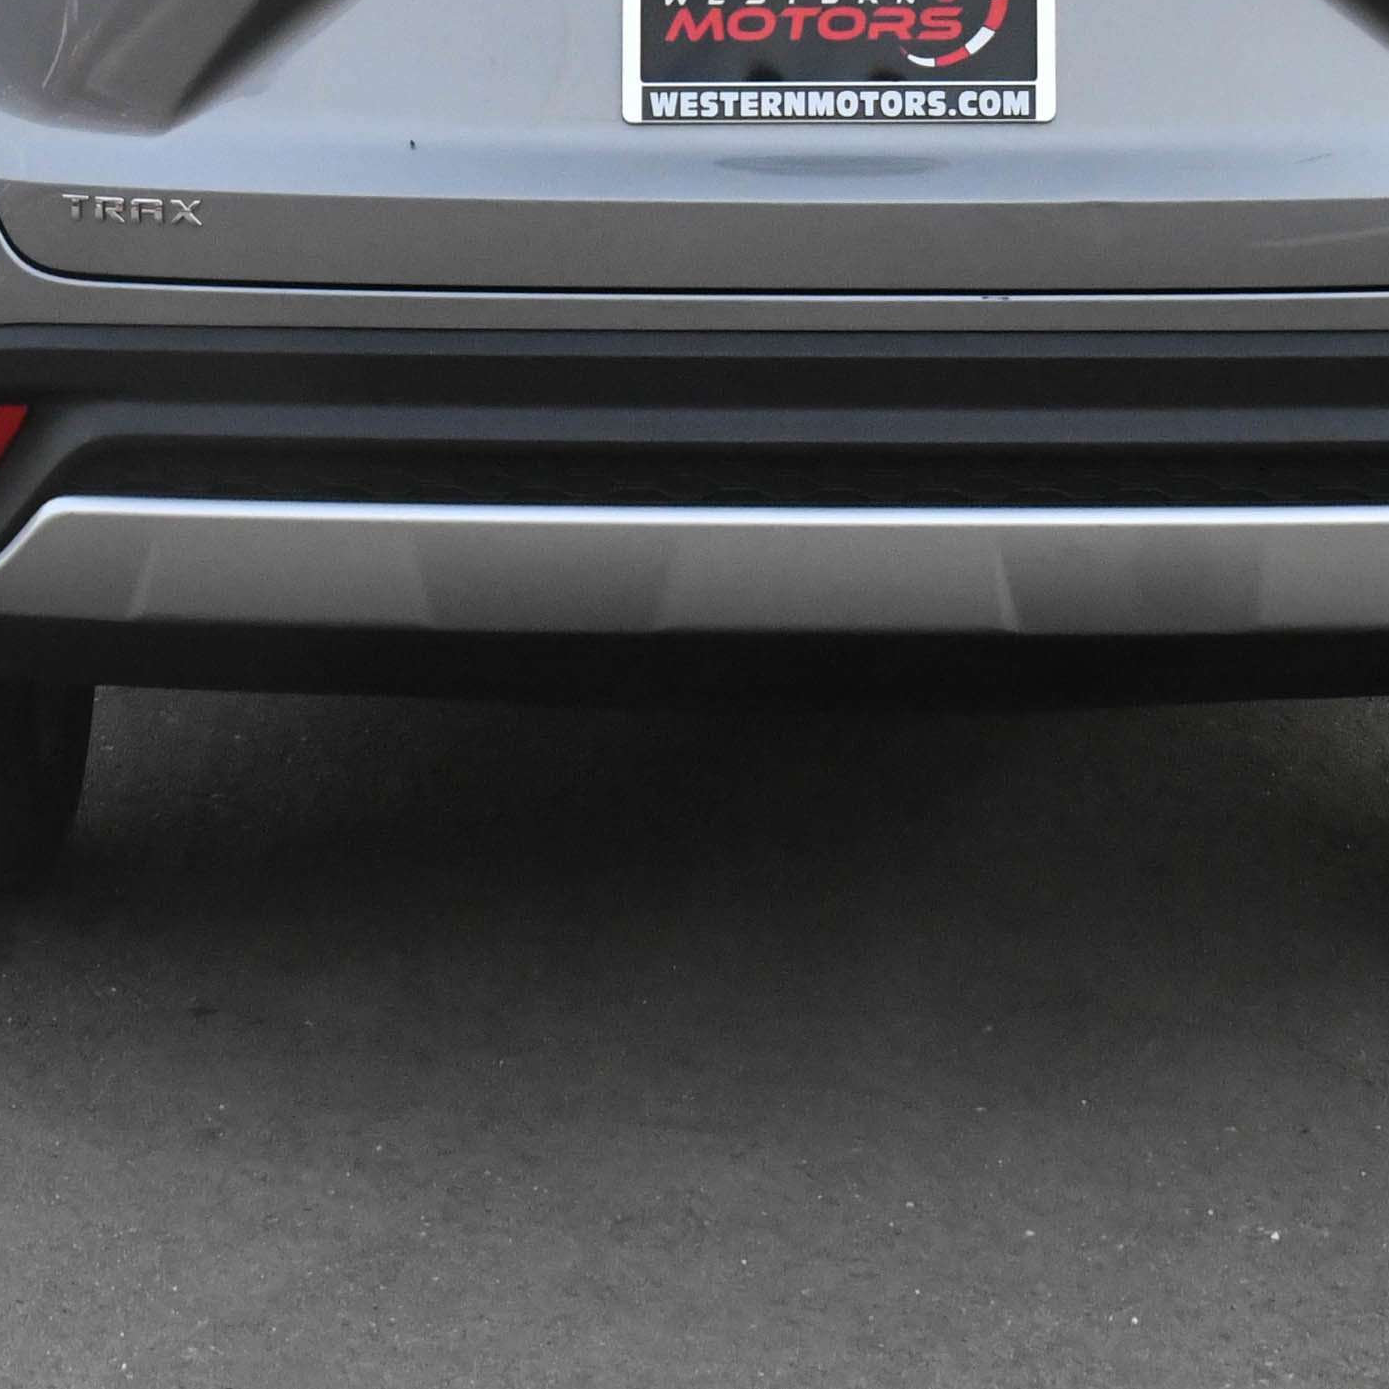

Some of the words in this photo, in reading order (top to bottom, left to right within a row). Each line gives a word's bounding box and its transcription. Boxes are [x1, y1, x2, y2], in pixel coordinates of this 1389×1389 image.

[665, 6, 964, 42] MOTORS
[649, 90, 1031, 118] WESTERNMOTORS.COM
[62, 193, 203, 226] TRAX
